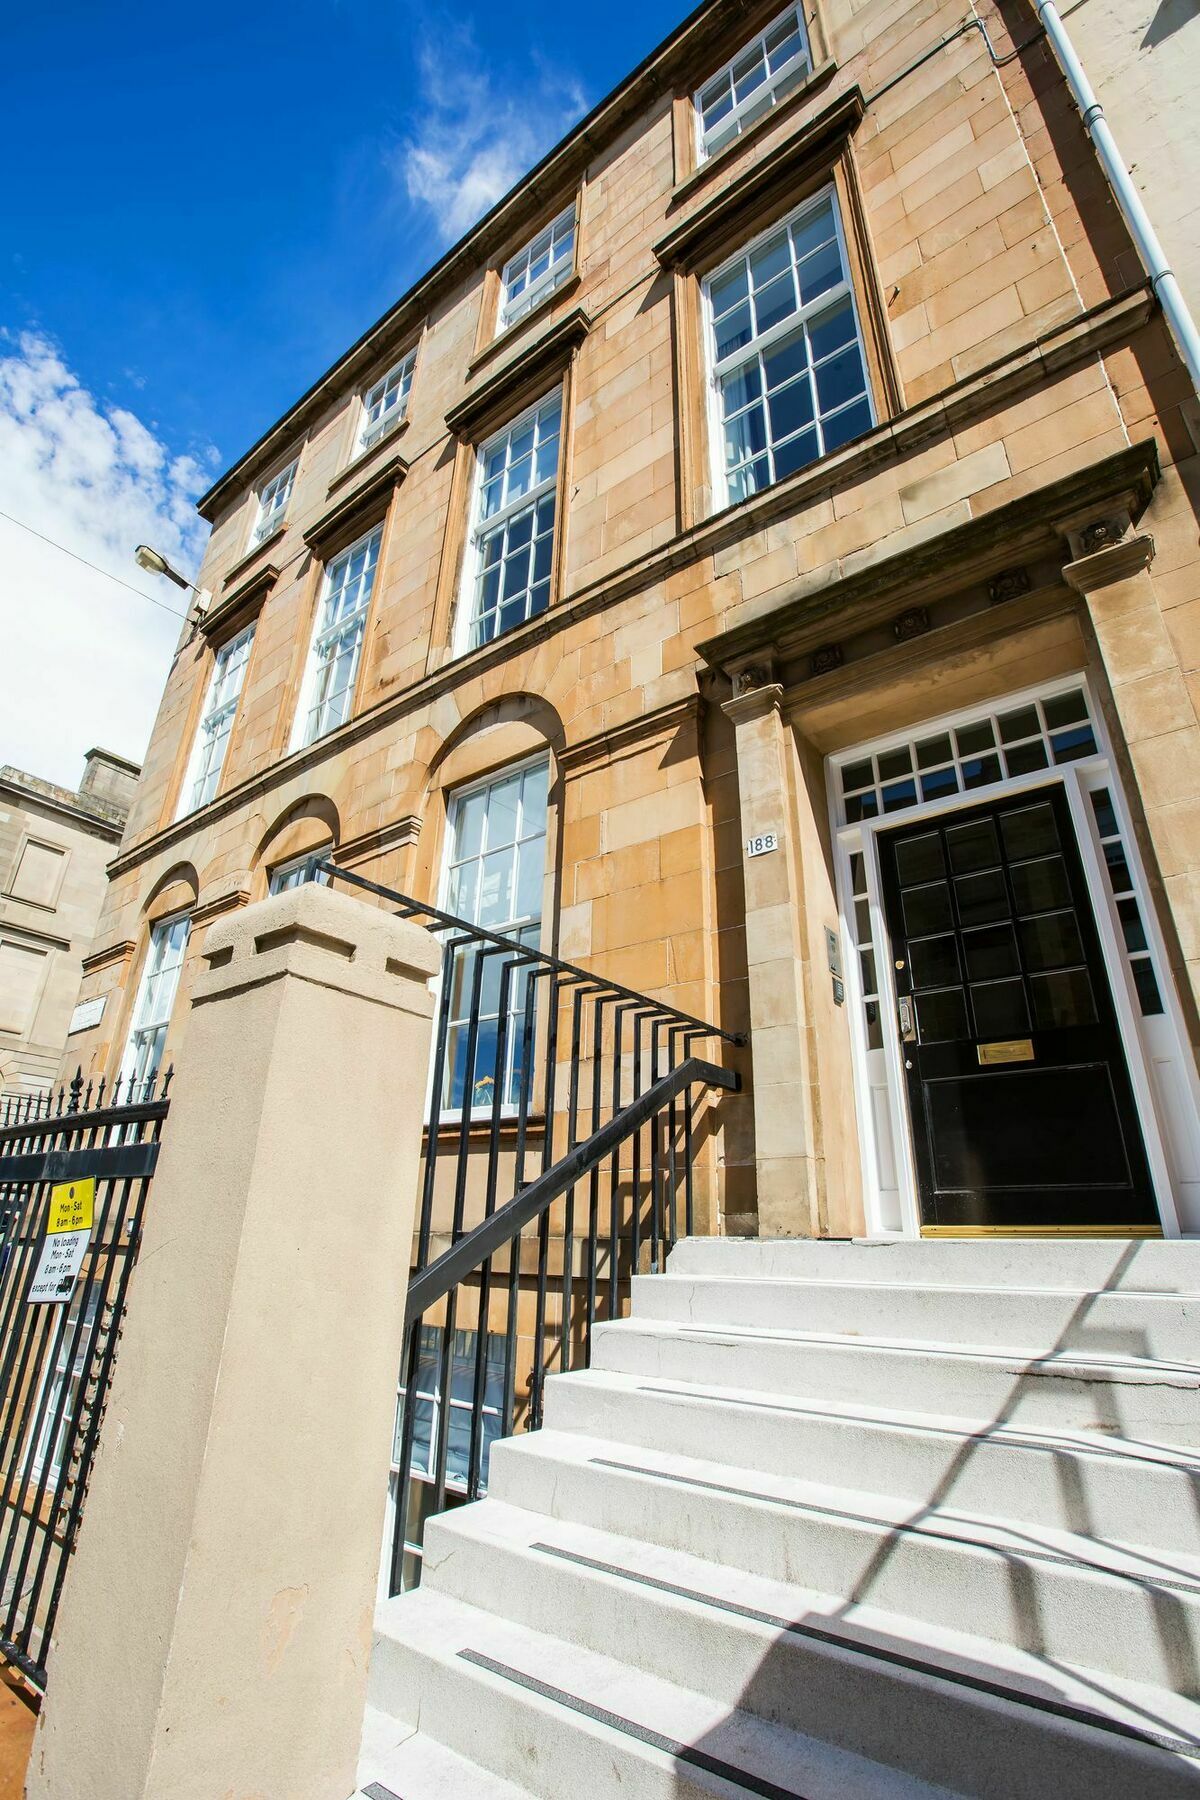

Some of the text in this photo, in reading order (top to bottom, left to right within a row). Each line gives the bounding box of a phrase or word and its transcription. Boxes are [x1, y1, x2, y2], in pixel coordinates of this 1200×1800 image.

[749, 835, 773, 853] 188
[60, 1203, 70, 1212] Mon
[74, 1200, 82, 1210] Sat
[53, 1235, 79, 1247] No loading
[51, 1250, 62, 1259] Mon
[65, 1248, 74, 1258] Sat
[32, 1282, 48, 1294] except
